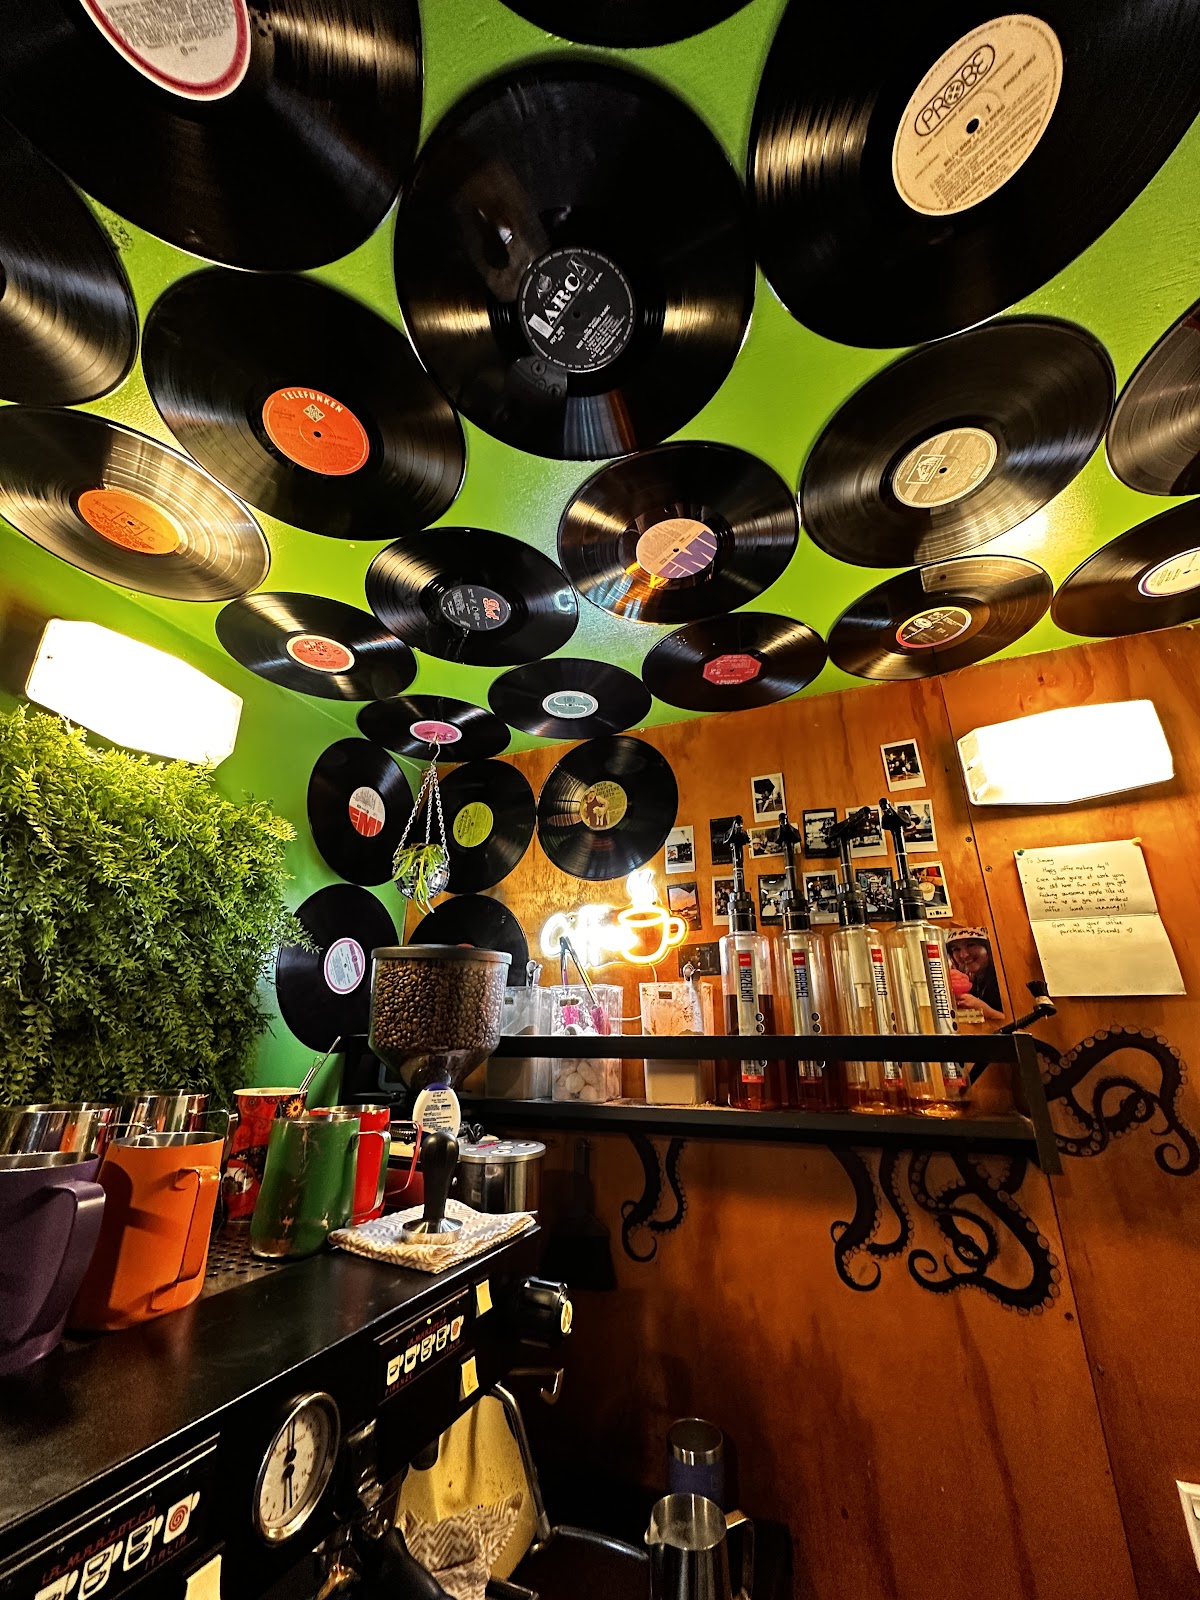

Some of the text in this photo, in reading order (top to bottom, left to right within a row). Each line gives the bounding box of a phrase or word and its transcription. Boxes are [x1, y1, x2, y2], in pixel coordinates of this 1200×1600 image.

[921, 51, 988, 130] PROBE
[281, 390, 344, 413] TELEFUNKEN
[740, 968, 754, 1003] HAZELNUT
[794, 967, 809, 999] CARAMEL
[873, 965, 888, 997] VANILLA
[928, 961, 951, 1020] BUTTERSCOTCH
[66, 1503, 156, 1569] MARZOCCO
[144, 1533, 189, 1572] ITALIA
